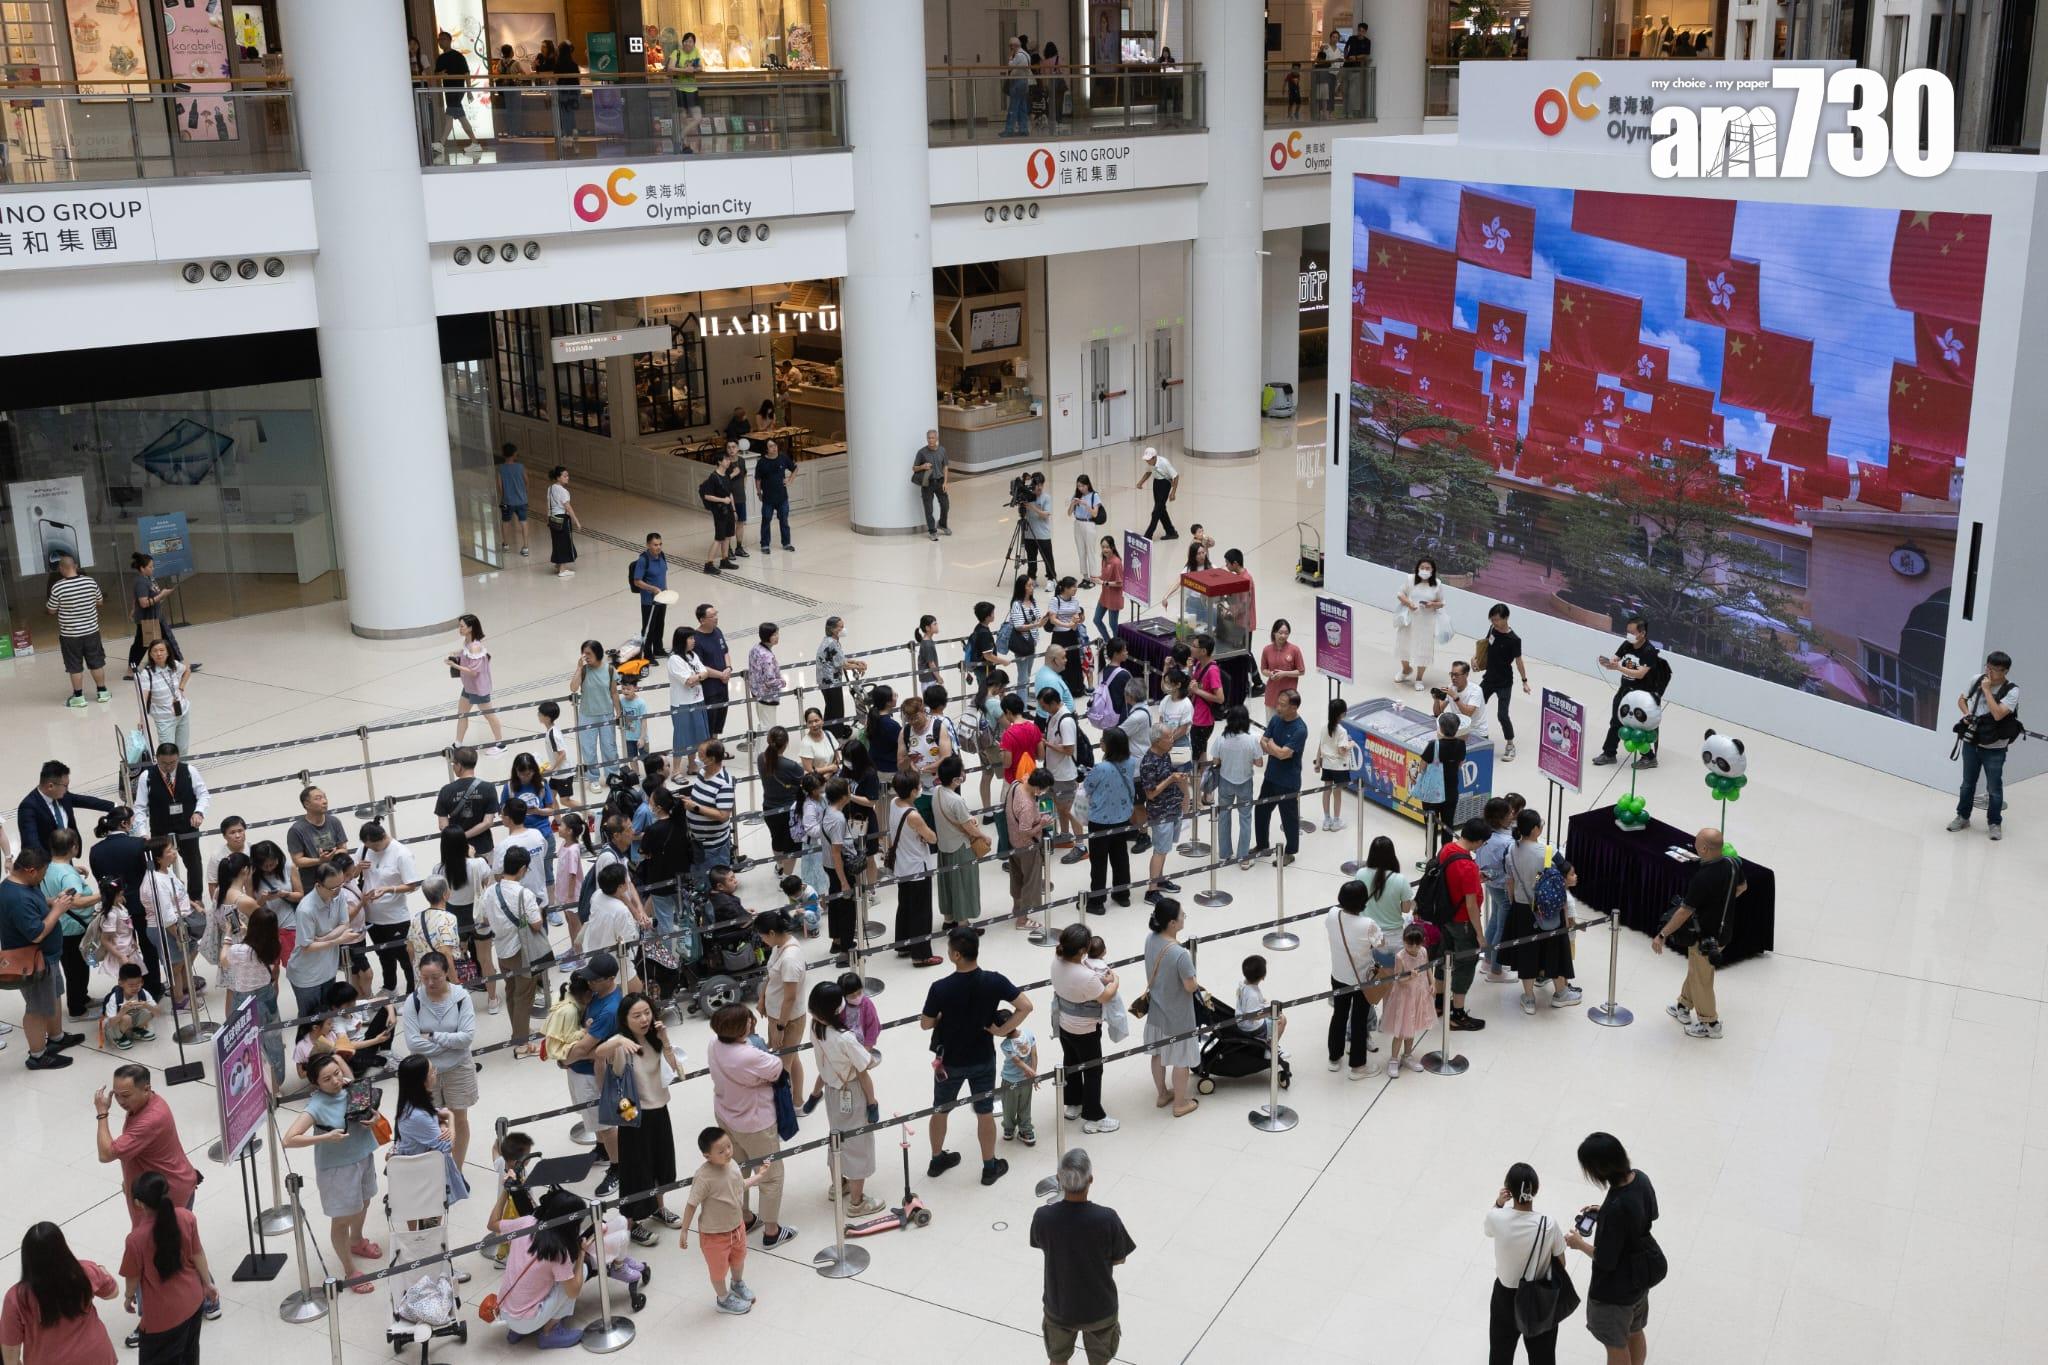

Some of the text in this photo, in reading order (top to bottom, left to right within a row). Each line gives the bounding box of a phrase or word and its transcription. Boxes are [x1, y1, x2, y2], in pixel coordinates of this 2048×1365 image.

[1060, 147, 1130, 163] SINO GROUP
[1061, 164, 1117, 184] 信和集團
[646, 184, 686, 199] 奧海城
[53, 200, 142, 222] GROUP
[646, 199, 752, 221] Olympian City
[1364, 738, 1405, 764] DRUMSTICK
[410, 1260, 421, 1270] OC
[443, 1250, 454, 1260] OC
[475, 1240, 485, 1250] OC
[507, 1231, 517, 1240] OC
[538, 1221, 548, 1231] OC
[569, 1212, 579, 1221] OC
